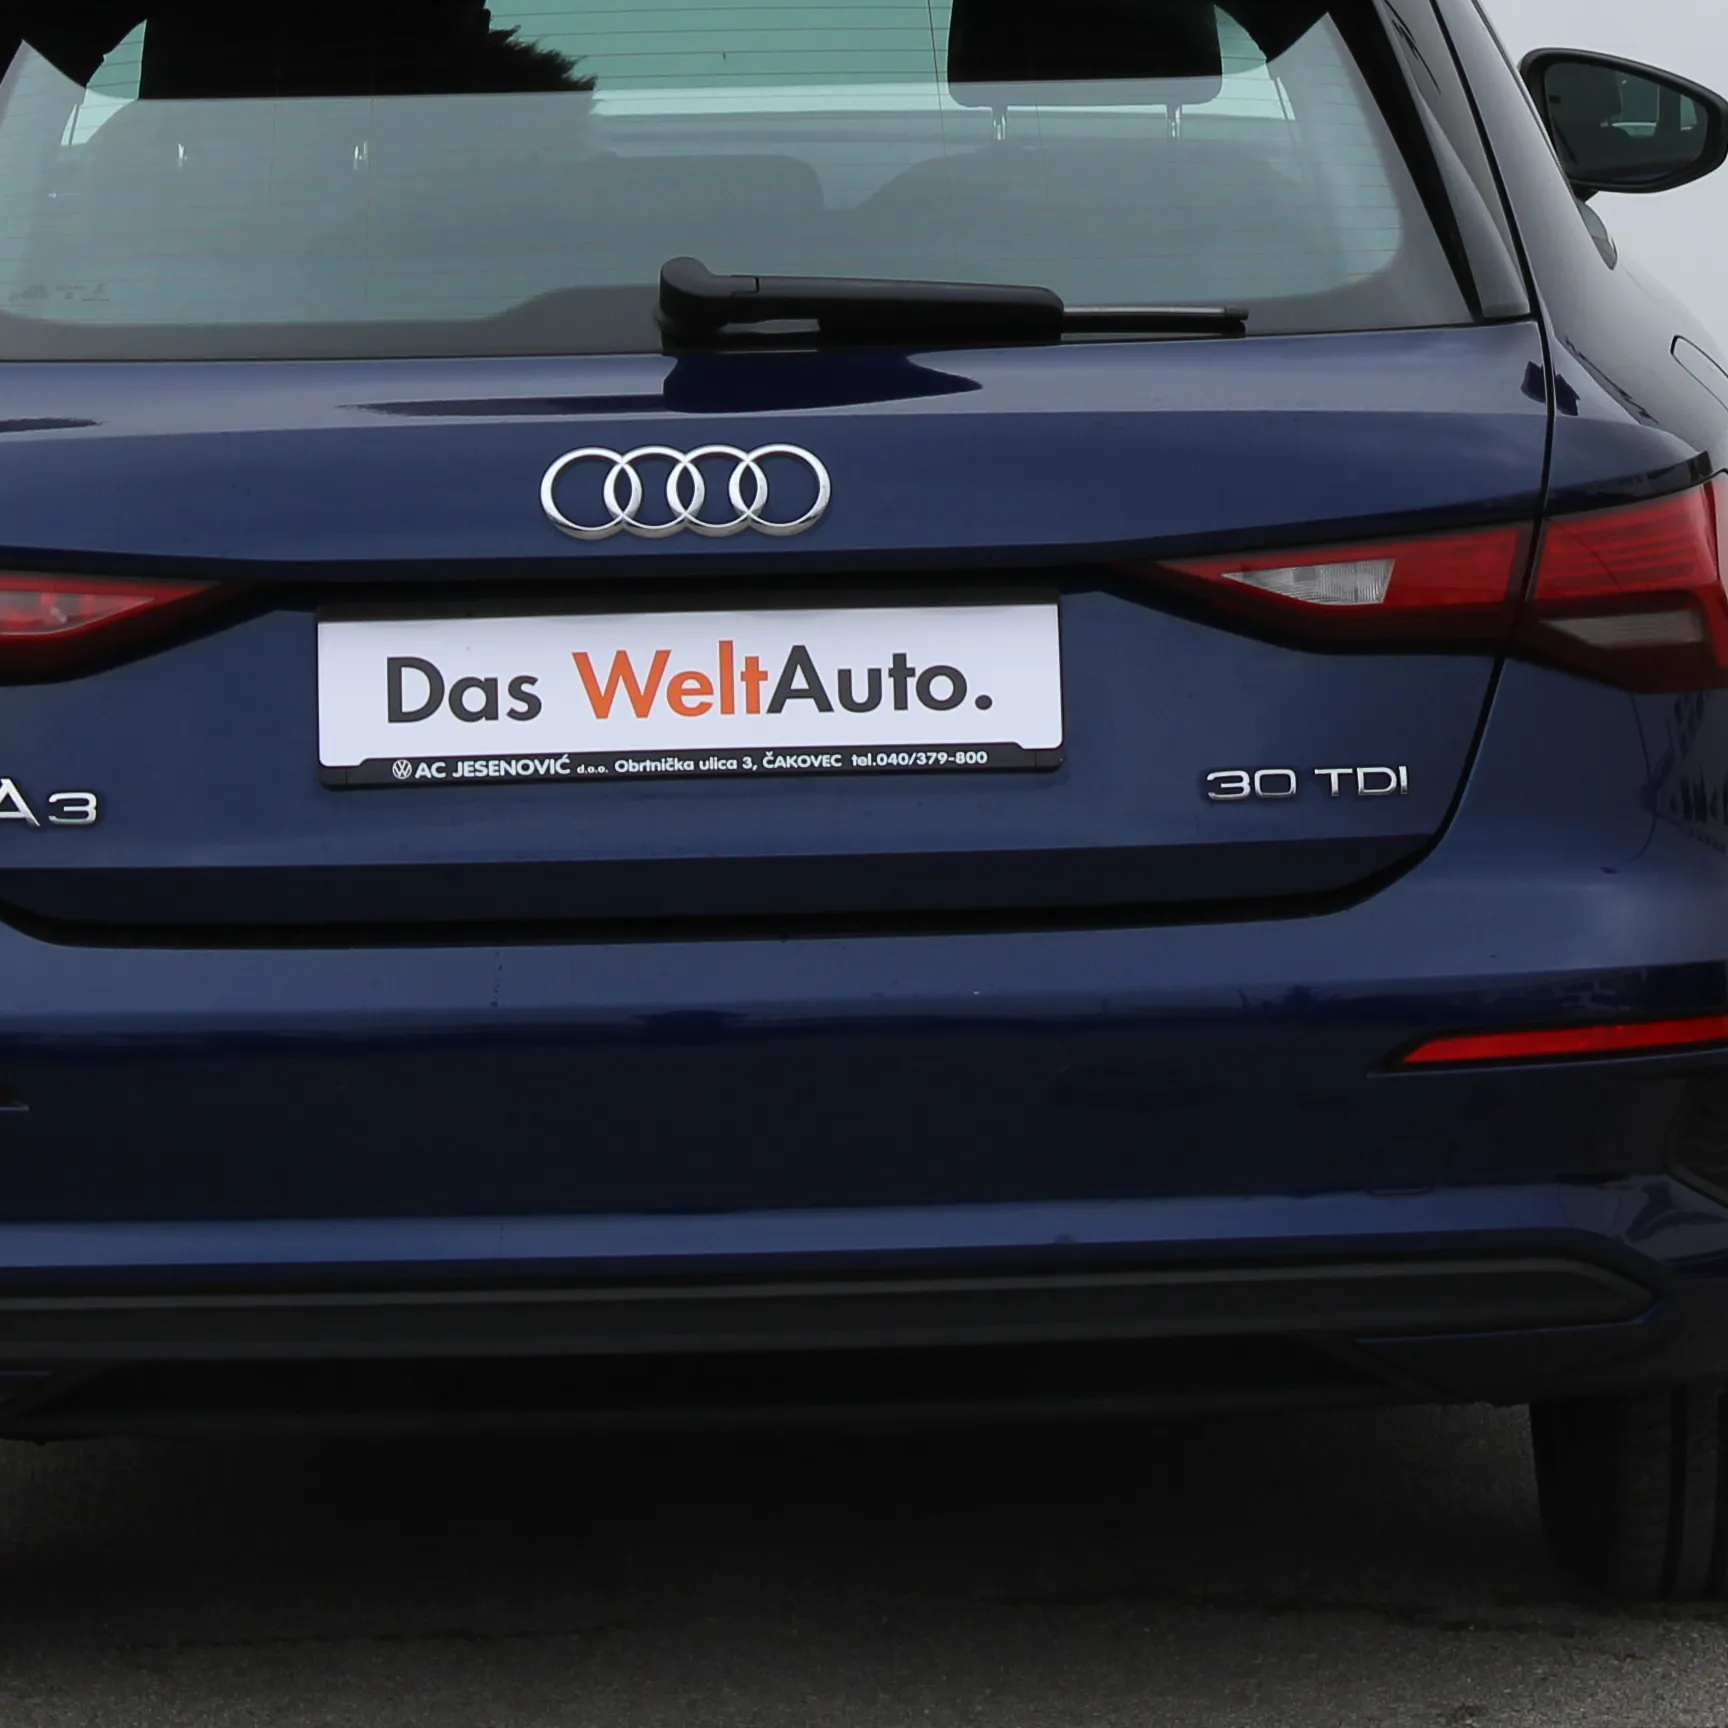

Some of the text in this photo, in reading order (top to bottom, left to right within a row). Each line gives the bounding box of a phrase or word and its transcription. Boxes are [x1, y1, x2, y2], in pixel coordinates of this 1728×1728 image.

[386, 639, 993, 724] Das WeltAuto.
[414, 750, 988, 779] AC JESENOVIĆ d.o.o. Obrtnička ulica 3, ČAKOVEC tel.040/379-800
[1205, 765, 1408, 801] 30 TDI
